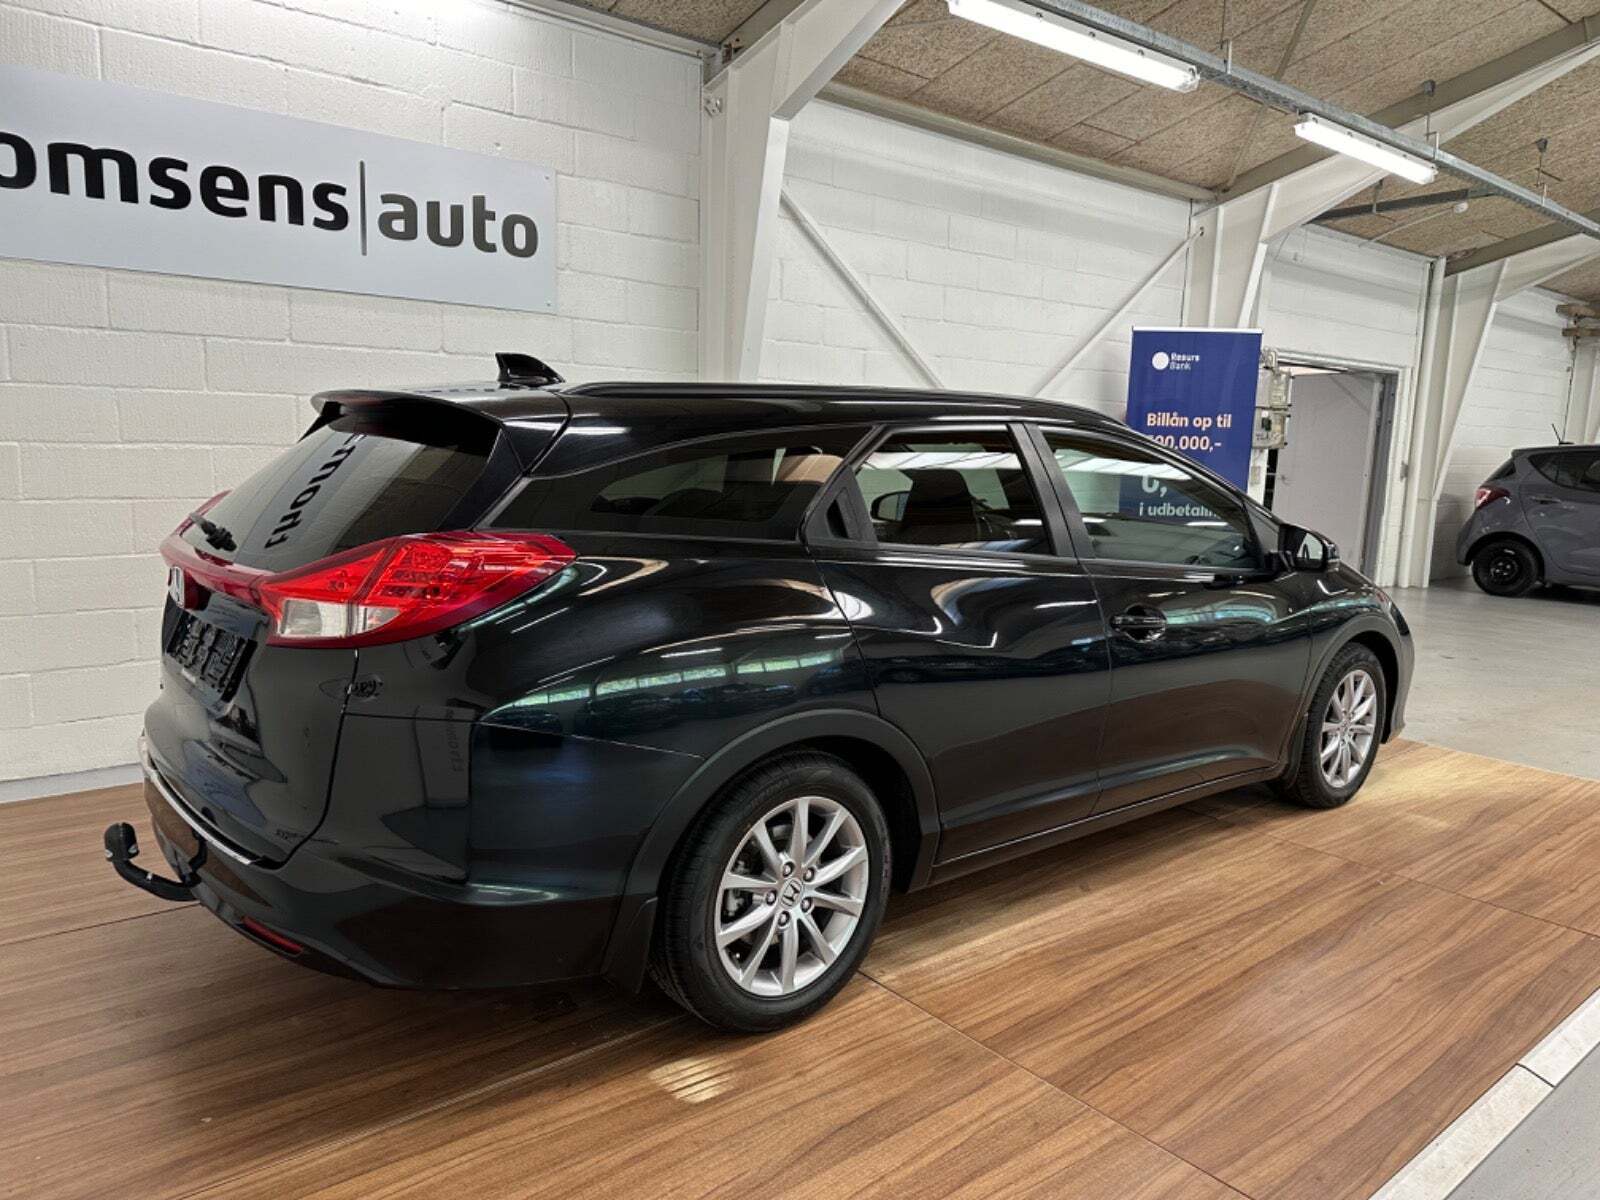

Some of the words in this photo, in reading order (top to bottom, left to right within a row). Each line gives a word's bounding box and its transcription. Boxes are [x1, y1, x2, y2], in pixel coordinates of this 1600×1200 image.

[377, 192, 538, 258] auto
[1146, 411, 1189, 427] Billån
[1193, 416, 1212, 431] op
[1216, 413, 1232, 428] til
[1139, 502, 1144, 517] i
